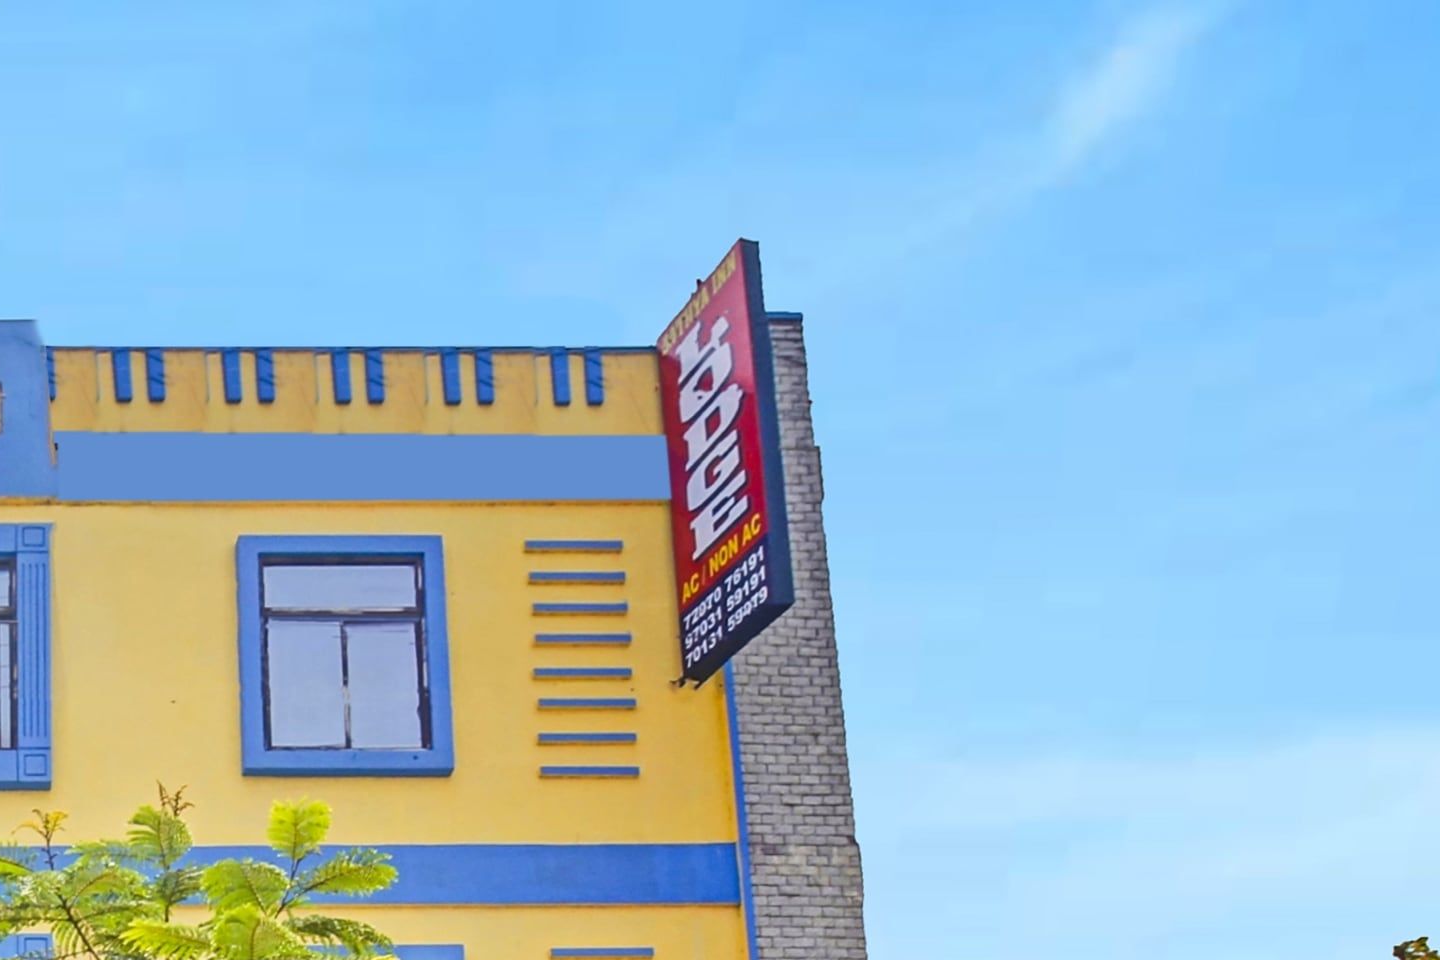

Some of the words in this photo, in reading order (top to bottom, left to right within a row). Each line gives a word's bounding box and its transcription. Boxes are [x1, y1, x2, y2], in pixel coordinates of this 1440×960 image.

[675, 316, 749, 561] LODGE
[682, 573, 700, 604] AC
[709, 534, 738, 577] NON
[742, 513, 761, 546] AC
